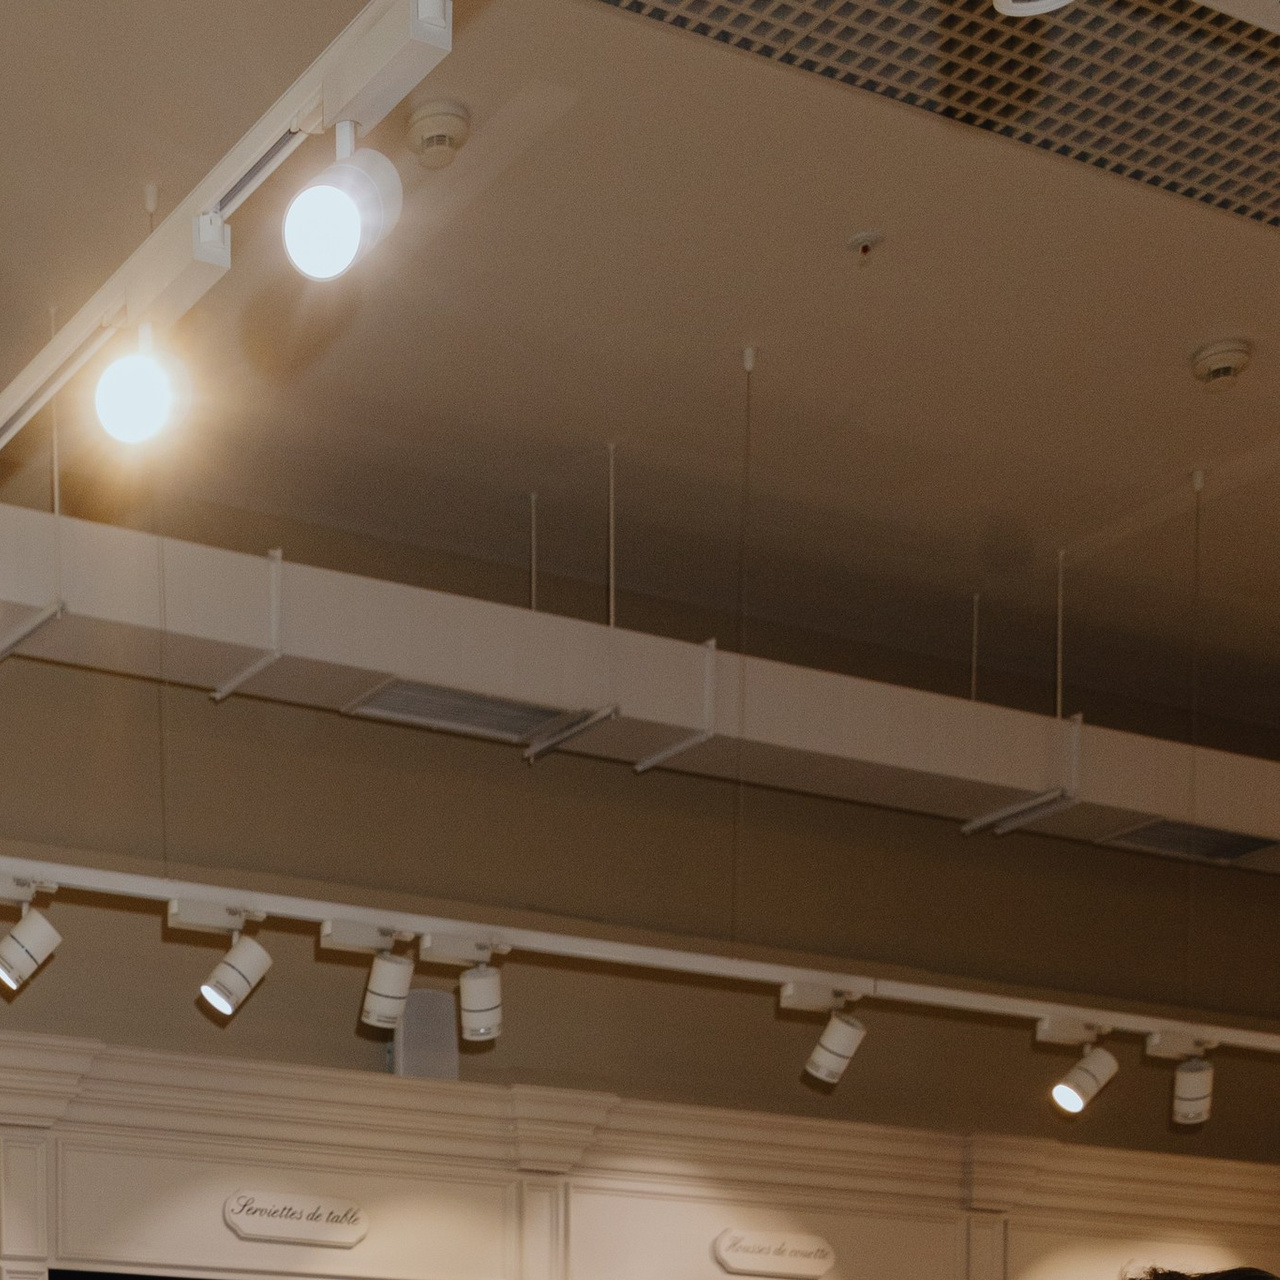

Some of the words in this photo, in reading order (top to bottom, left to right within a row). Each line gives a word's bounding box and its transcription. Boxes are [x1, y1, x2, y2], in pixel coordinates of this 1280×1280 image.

[231, 1195, 303, 1221] Serviettes
[306, 1205, 321, 1223] de
[325, 1208, 360, 1226] table
